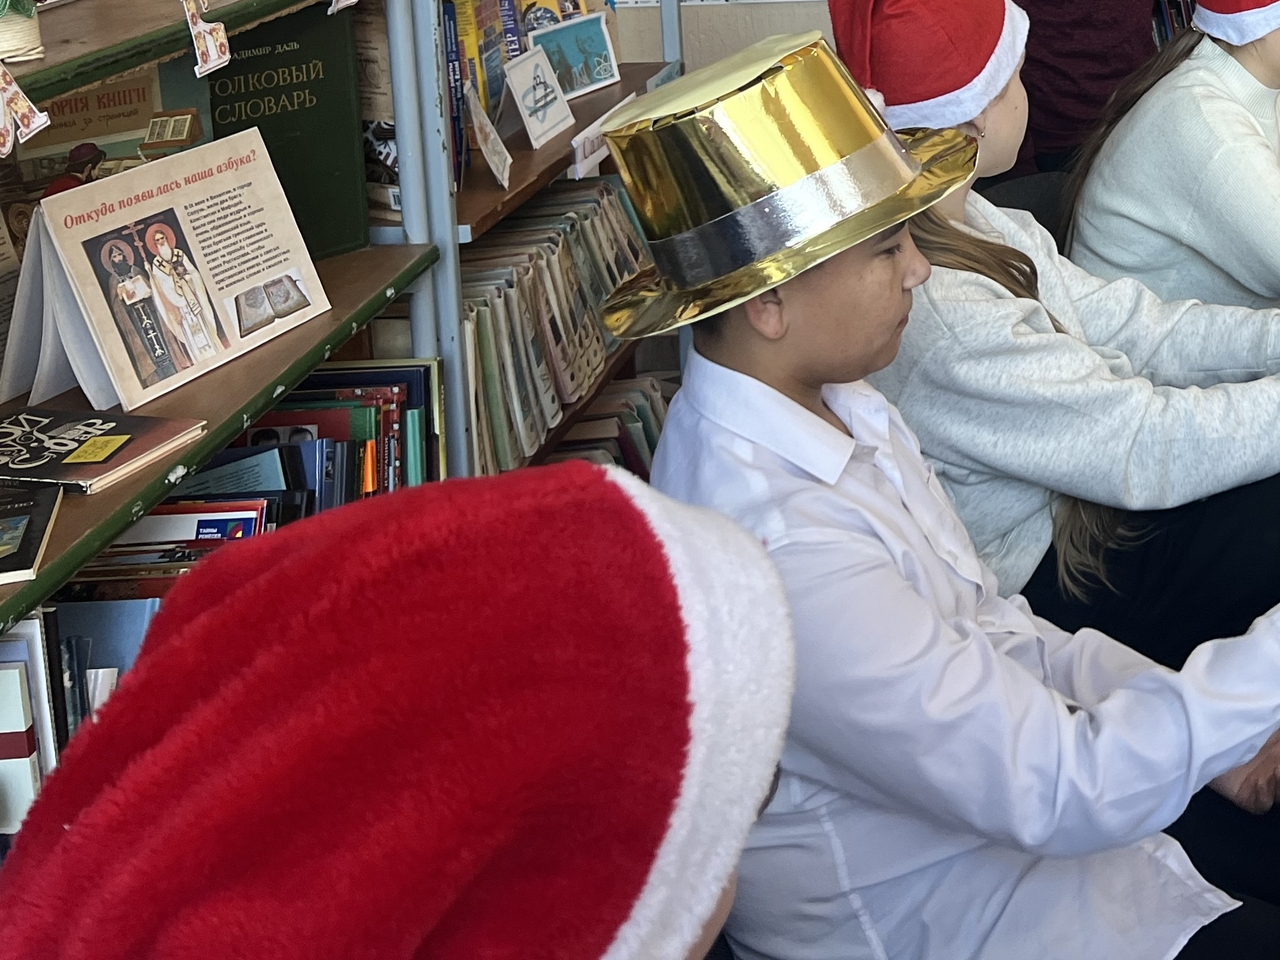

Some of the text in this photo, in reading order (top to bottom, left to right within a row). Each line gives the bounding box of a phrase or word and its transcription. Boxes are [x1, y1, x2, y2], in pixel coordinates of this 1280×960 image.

[231, 40, 300, 62] АДИМИР ДАЛЬ
[95, 85, 148, 111] КНИГИ
[214, 90, 317, 125] СЛОВАРЬ
[62, 148, 258, 230] Откуда появилась наша азбука?
